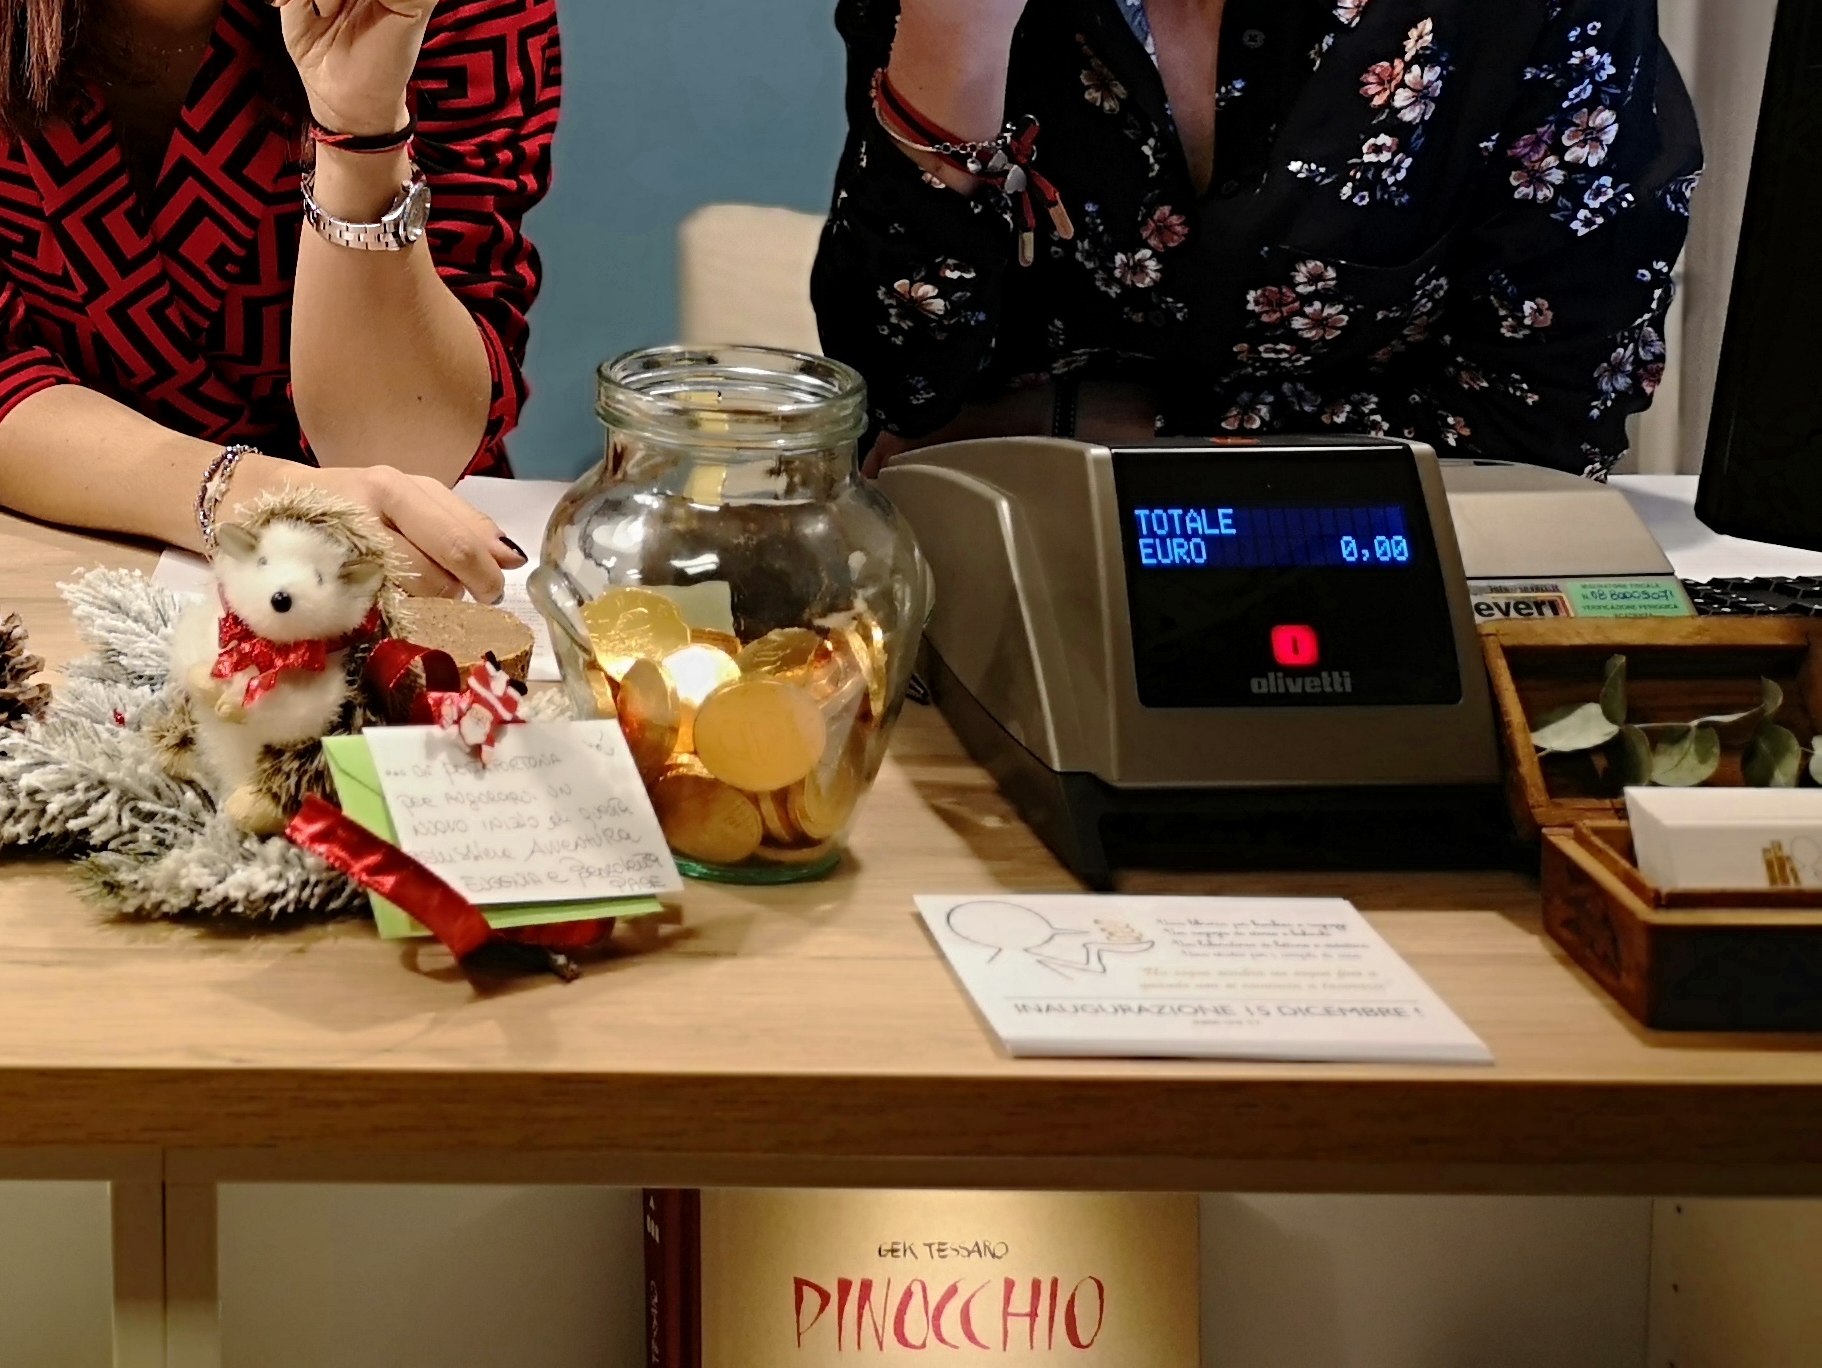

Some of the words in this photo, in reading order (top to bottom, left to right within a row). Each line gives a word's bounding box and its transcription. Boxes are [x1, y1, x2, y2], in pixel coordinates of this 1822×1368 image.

[1134, 508, 1236, 535] TOTALE
[1138, 537, 1207, 564] EURO
[1340, 535, 1408, 561] 0,00
[1250, 671, 1352, 693] olivetti
[1014, 1002, 1235, 1017] INAUGURAZIONE
[878, 1240, 918, 1259] GEK
[924, 1240, 1009, 1260] TESSARO
[793, 1275, 1105, 1352] PINOCCHIO
